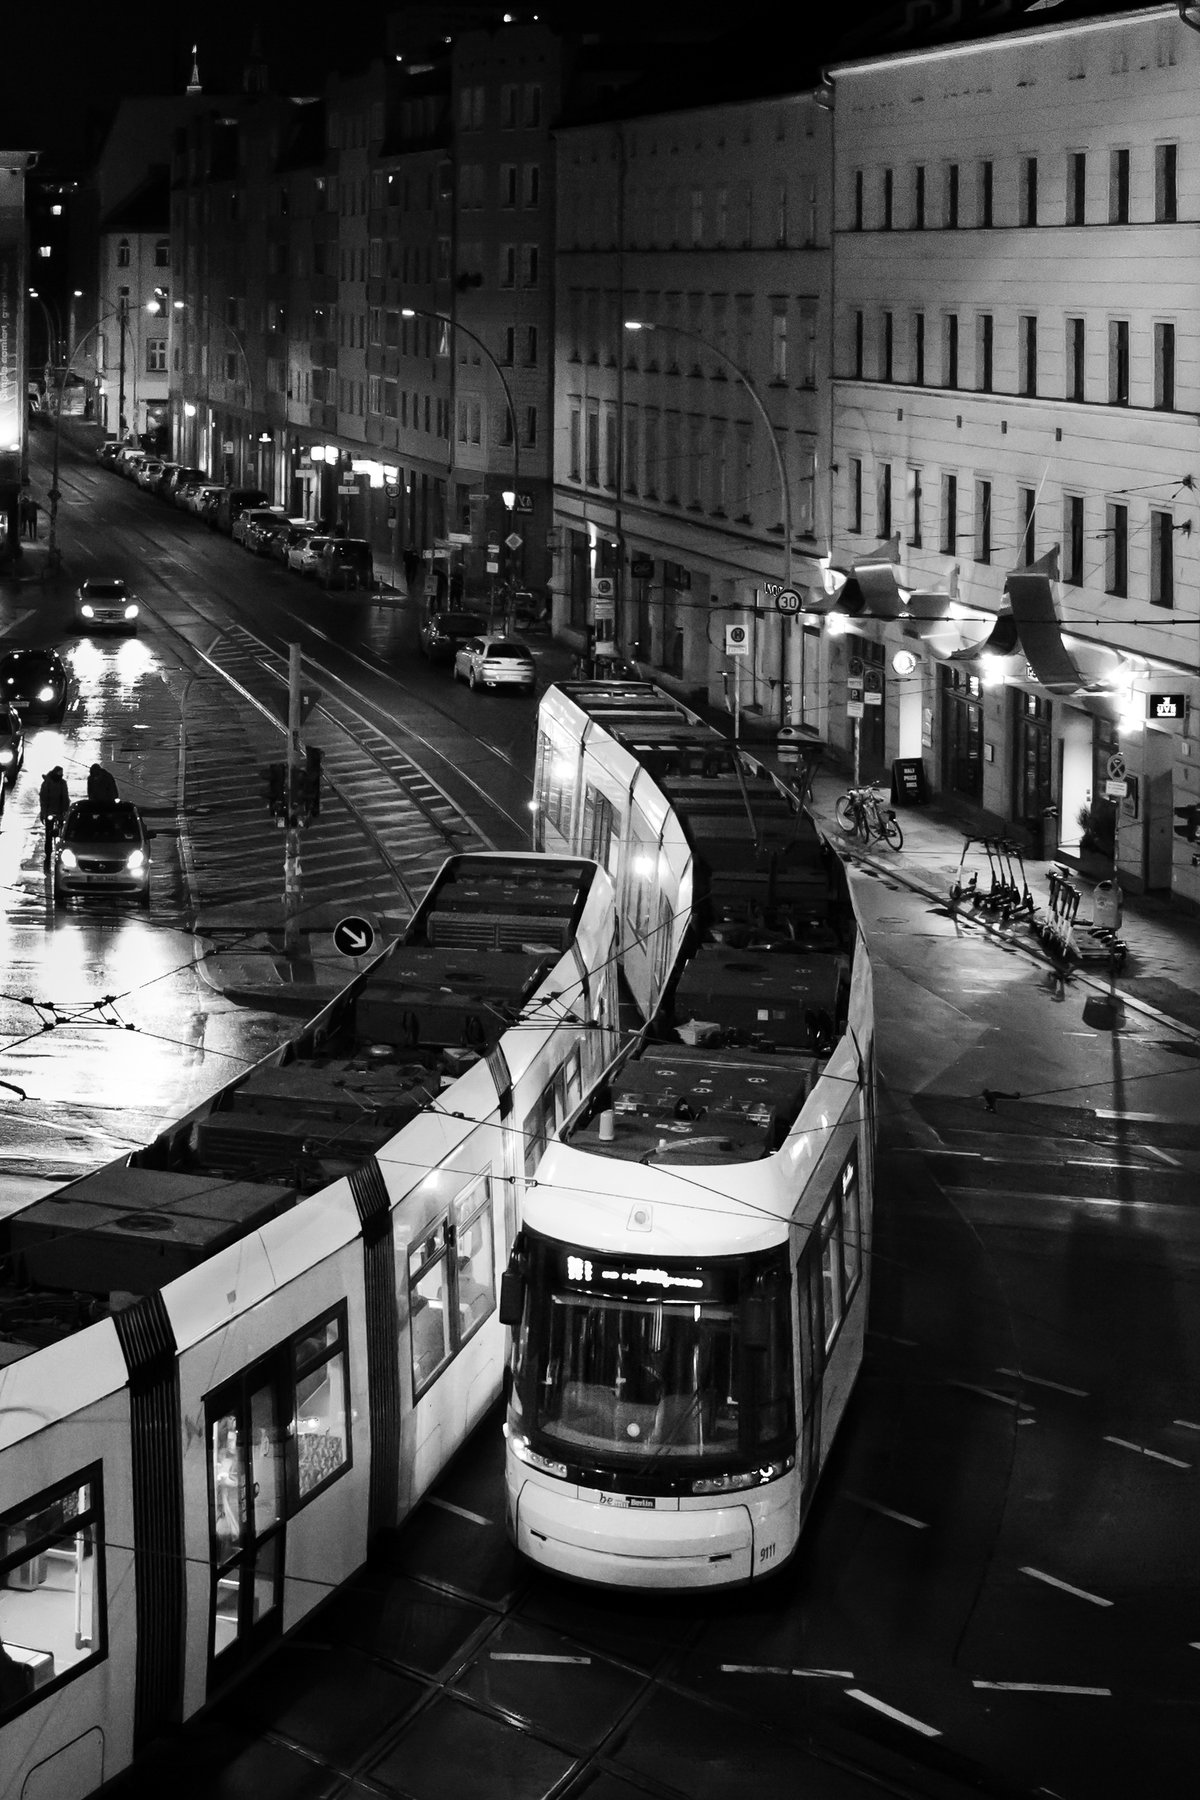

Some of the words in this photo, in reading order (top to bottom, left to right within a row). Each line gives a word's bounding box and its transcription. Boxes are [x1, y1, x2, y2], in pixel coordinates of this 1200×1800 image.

[781, 596, 796, 609] 30
[734, 630, 742, 640] H
[630, 1498, 654, 1507] Berlin
[760, 1542, 776, 1562] 9111
